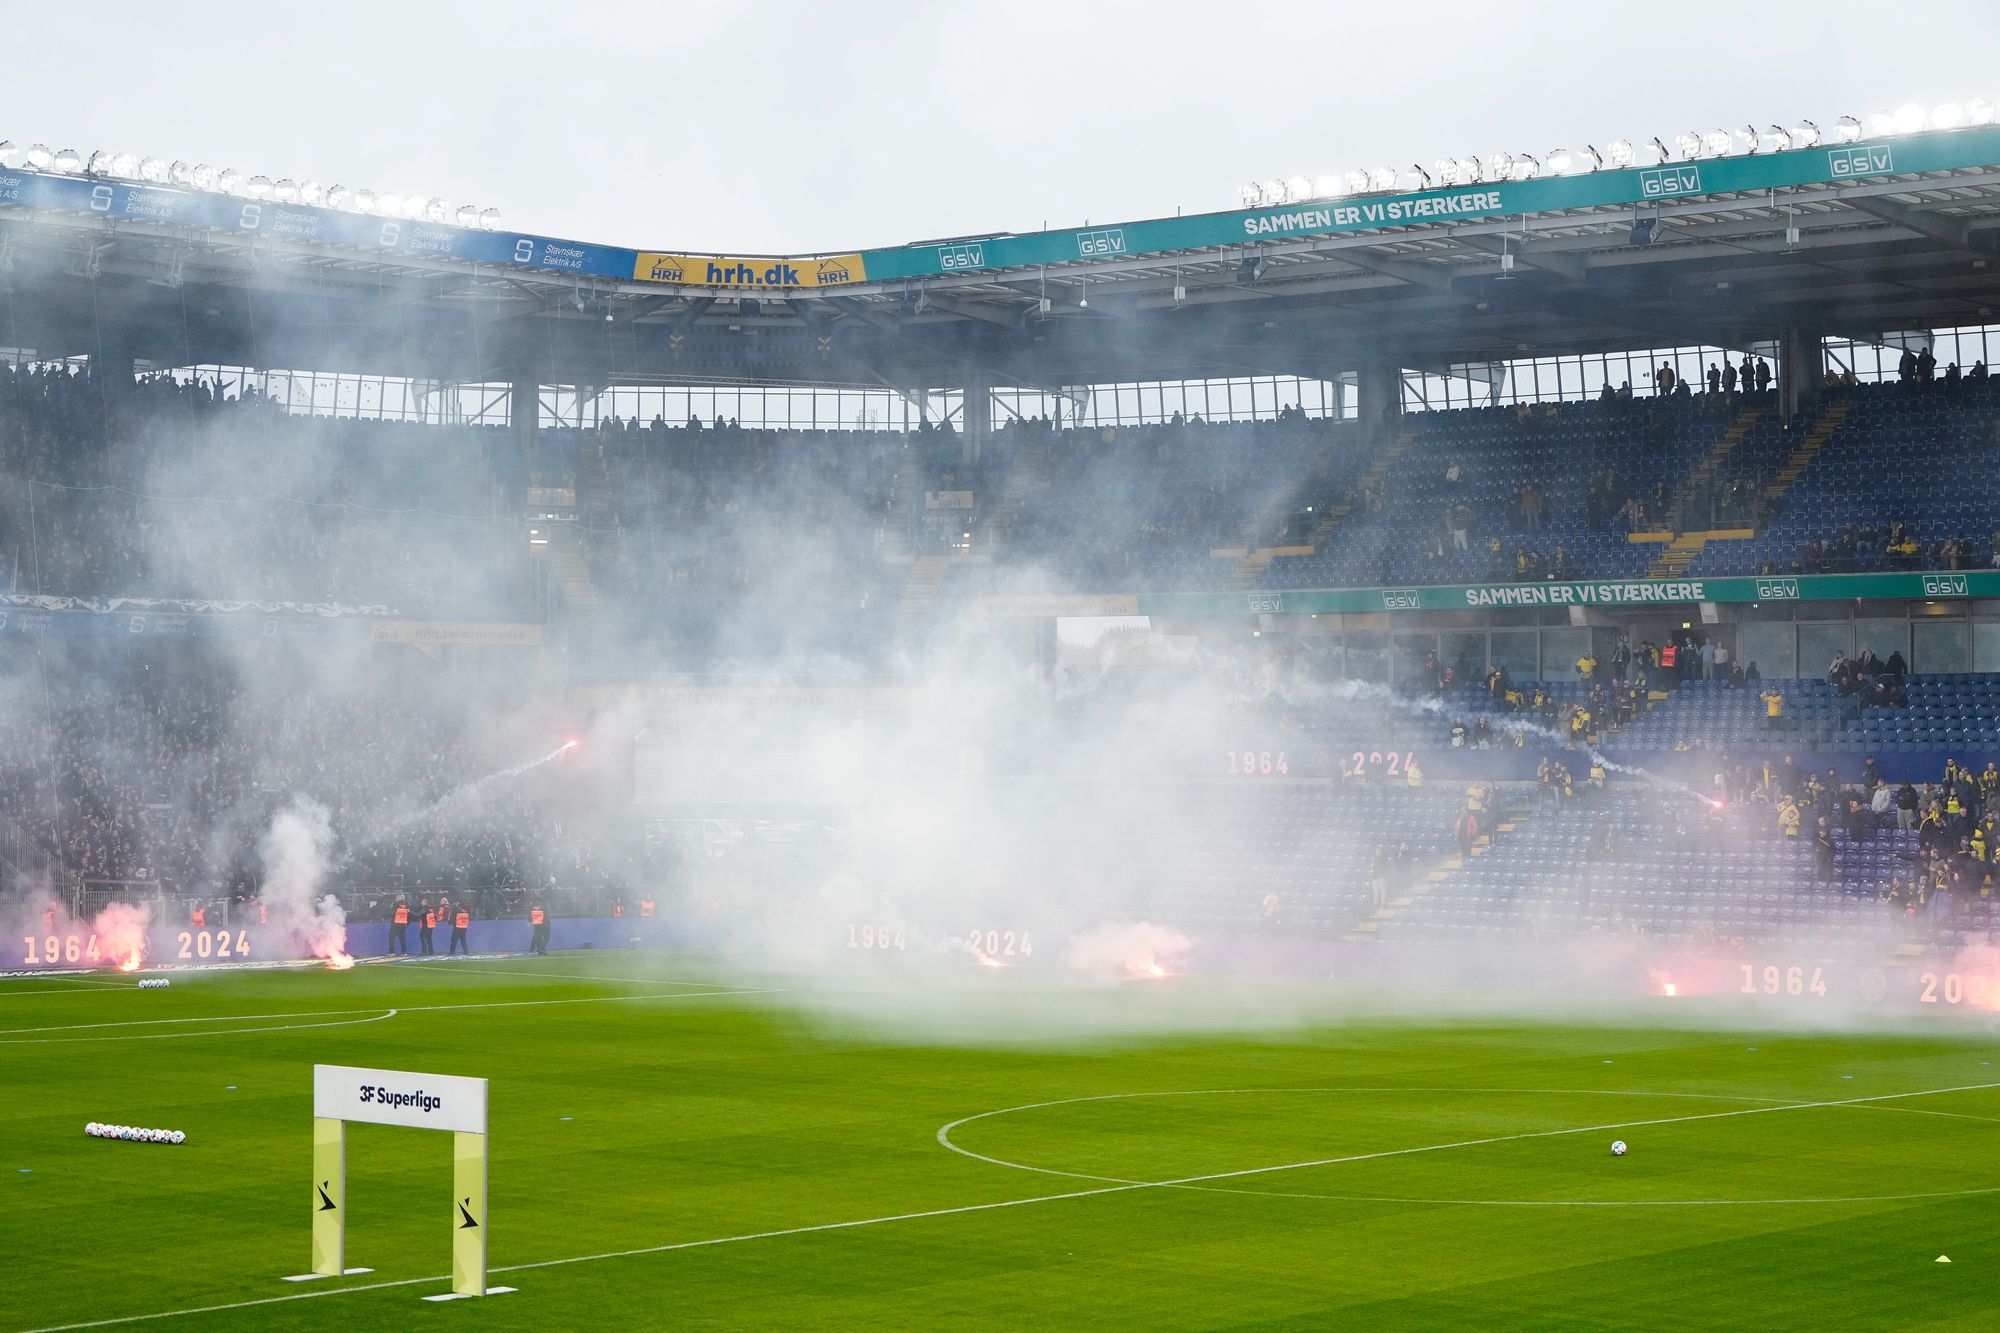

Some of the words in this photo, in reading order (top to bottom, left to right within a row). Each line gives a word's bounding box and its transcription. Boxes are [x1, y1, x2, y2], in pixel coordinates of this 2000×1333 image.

[1833, 154, 1889, 174] GSV
[1644, 174, 1696, 193] GSV
[127, 190, 177, 206] Stavnskær
[125, 203, 158, 216] Elektrik
[159, 208, 173, 218] A/S
[274, 209, 321, 225] Stavnskær
[1244, 210, 1331, 235] SAMMEN
[1334, 206, 1361, 226] ER
[1361, 203, 1385, 222] VI
[1386, 191, 1502, 220] STÆRKERE
[272, 222, 304, 234] Elektrik
[304, 226, 318, 236] A/S
[413, 227, 455, 242] Stavnskær
[410, 239, 440, 251] Elektrik
[440, 243, 452, 253] A/S
[545, 244, 586, 258] Stavnskær
[1081, 236, 1122, 254] GSV
[543, 255, 570, 267] Elektrik
[570, 259, 583, 269] A/S
[942, 252, 981, 269] GSV
[651, 268, 683, 281] HRH
[706, 262, 800, 285] hrh.dk
[817, 271, 849, 284] HRH
[1466, 586, 1546, 606] SAMMEN
[1549, 585, 1575, 603] ER
[1575, 585, 1597, 602] VI
[1599, 582, 1706, 601] STÆRKERE
[1760, 586, 1796, 598] GSV
[1925, 581, 1965, 593] GSV
[1250, 599, 1280, 612] GSV
[1385, 595, 1417, 608] GSV
[1226, 751, 1289, 775] 1964
[24, 934, 101, 964] 1964
[178, 930, 250, 959] 2024
[848, 923, 906, 951] 1964
[969, 929, 1033, 957] 2024
[1740, 964, 1828, 997] 1964
[359, 1085, 375, 1103] 3F
[377, 1086, 441, 1113] Superliga
